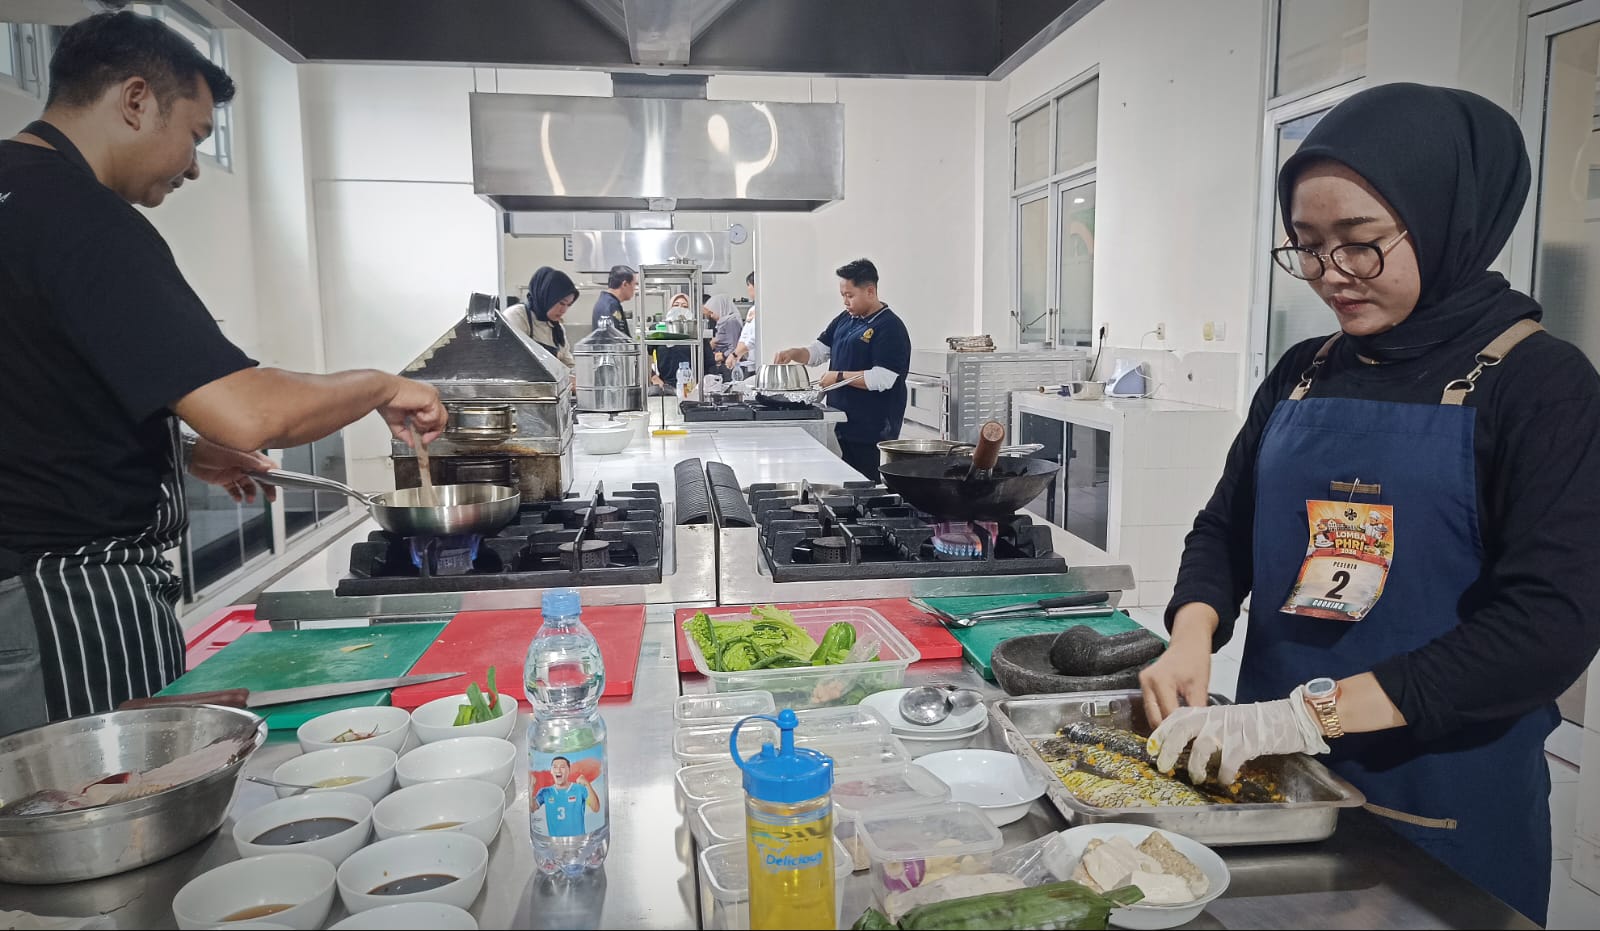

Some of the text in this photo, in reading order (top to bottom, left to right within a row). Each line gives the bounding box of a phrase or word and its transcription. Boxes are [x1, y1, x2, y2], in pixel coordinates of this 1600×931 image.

[1336, 531, 1366, 542] LOMBA
[1335, 539, 1365, 551] PHRI
[1325, 571, 1350, 599] 2
[557, 806, 566, 820] 3
